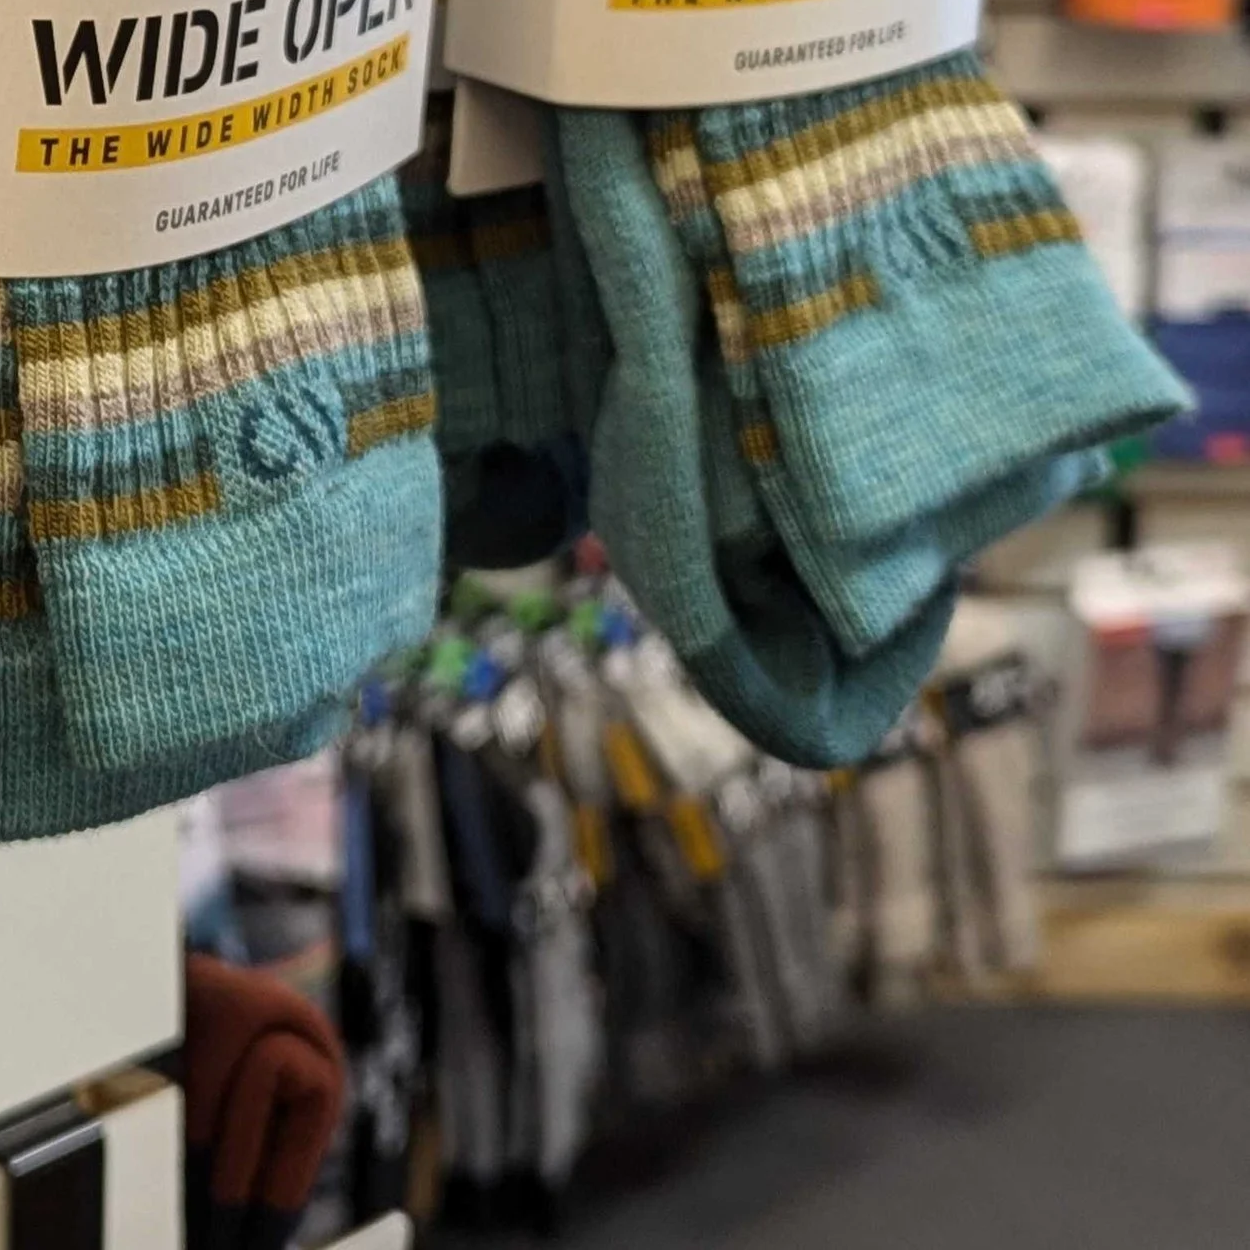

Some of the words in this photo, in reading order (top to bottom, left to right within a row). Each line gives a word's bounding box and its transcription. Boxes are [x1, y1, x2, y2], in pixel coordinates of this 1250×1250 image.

[734, 36, 845, 72] GUARANTEED
[849, 29, 876, 51] FOR
[878, 20, 905, 43] LIFE
[40, 135, 120, 166] THE
[147, 114, 235, 158] WIDE
[252, 79, 334, 133] WIDTH
[155, 180, 274, 232] GUARANTEED
[278, 163, 307, 194] FOR
[311, 150, 339, 182] LIFE
